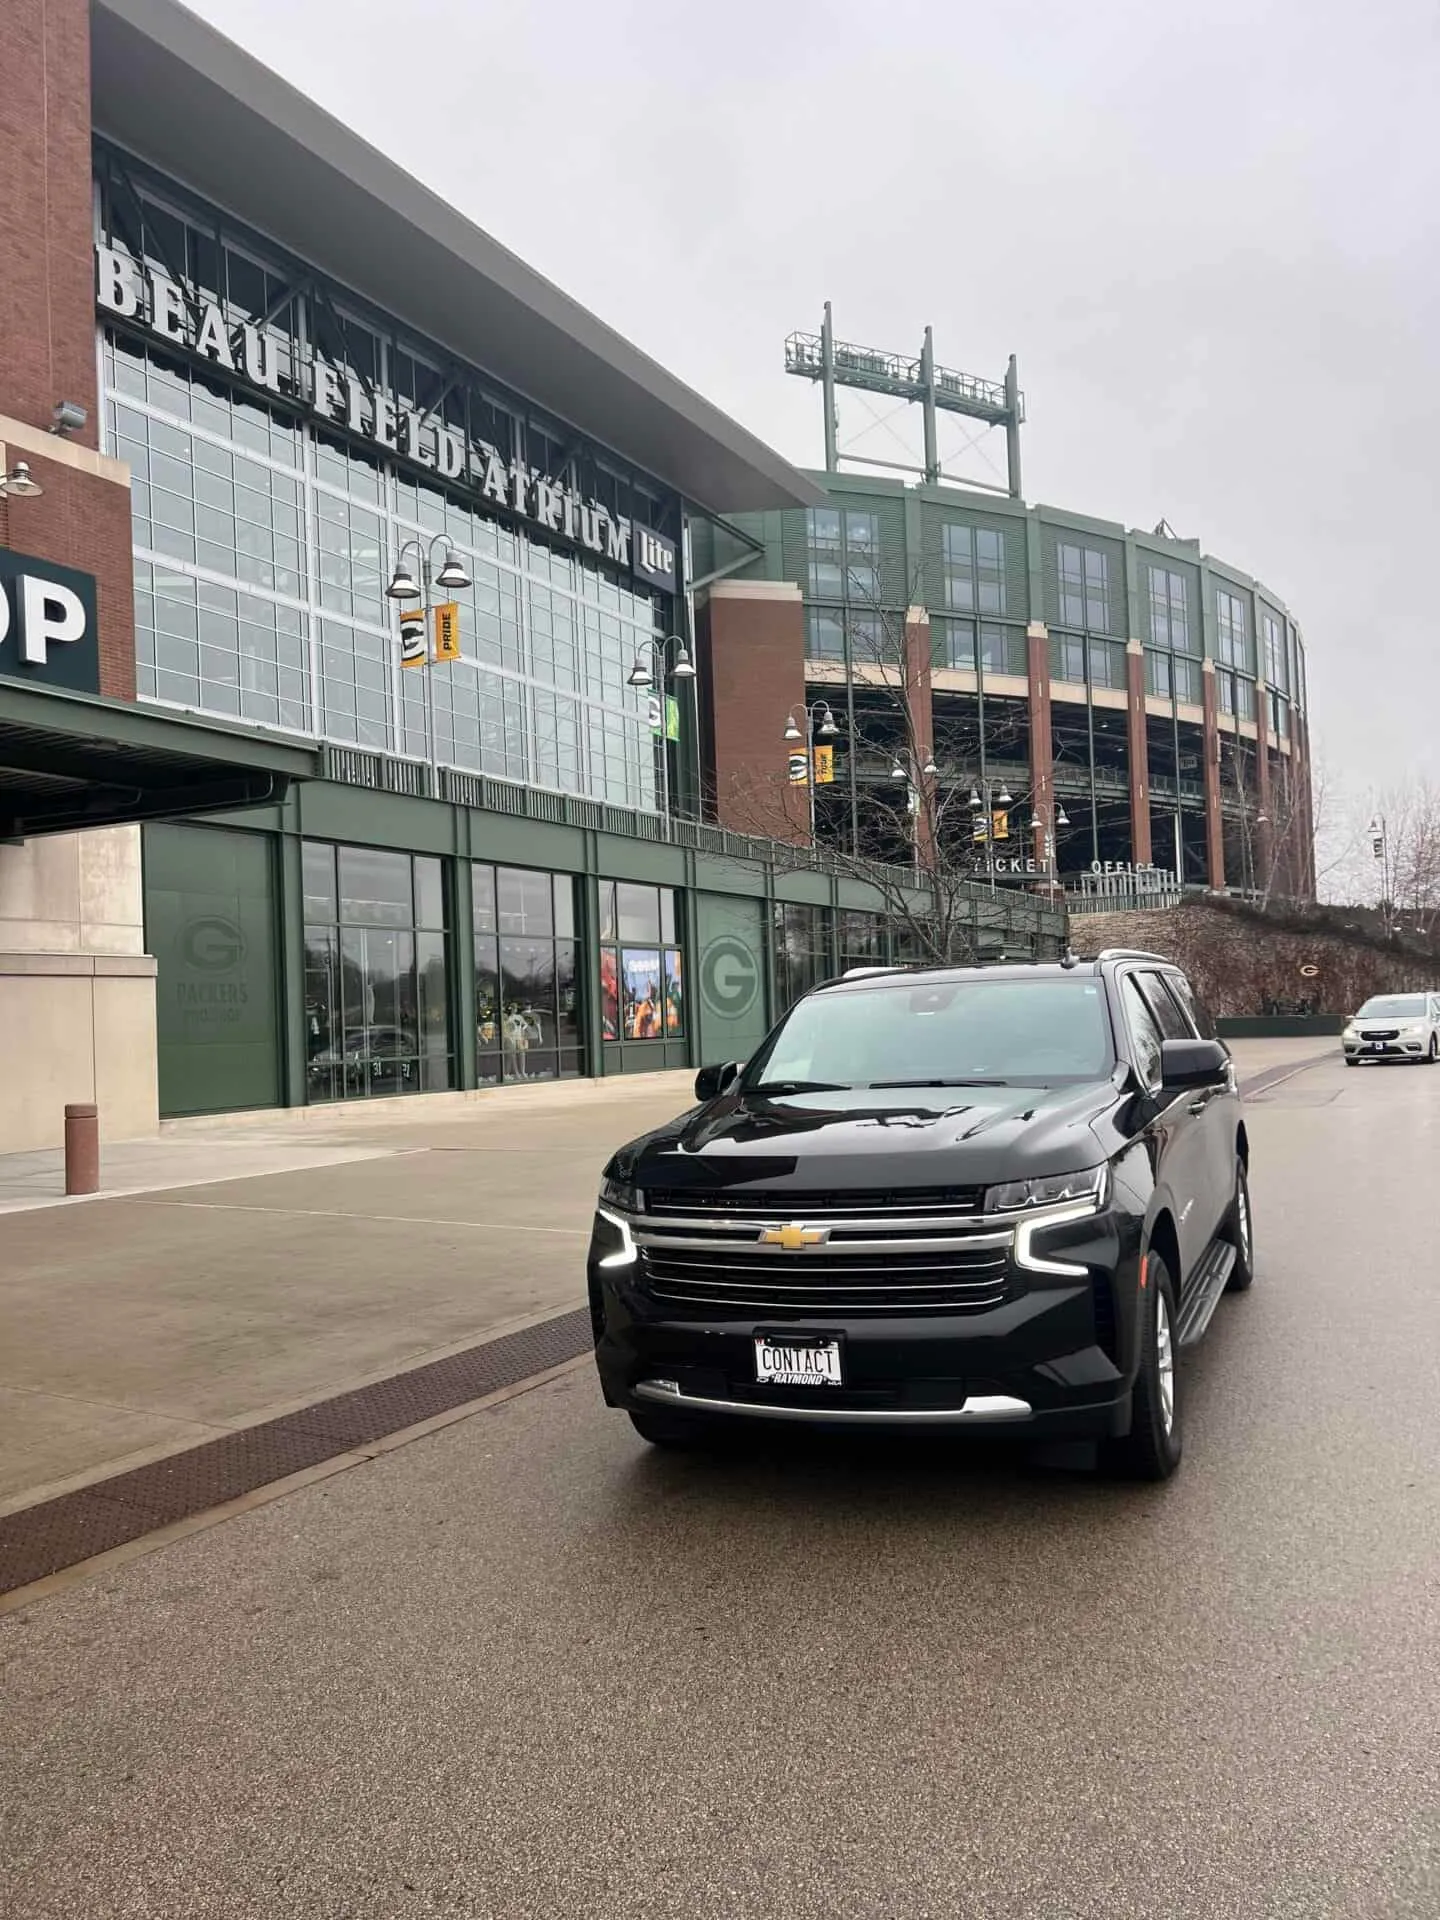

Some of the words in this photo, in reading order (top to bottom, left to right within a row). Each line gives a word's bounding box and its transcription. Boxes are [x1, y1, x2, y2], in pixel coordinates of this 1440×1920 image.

[312, 359, 466, 479] FIELD
[482, 452, 631, 567] ATRIUM
[638, 530, 673, 574] Lite
[441, 612, 453, 651] PRIDE
[701, 940, 757, 1015] G
[762, 1347, 833, 1375] CONTACT
[773, 1373, 824, 1386] RAYMOND
